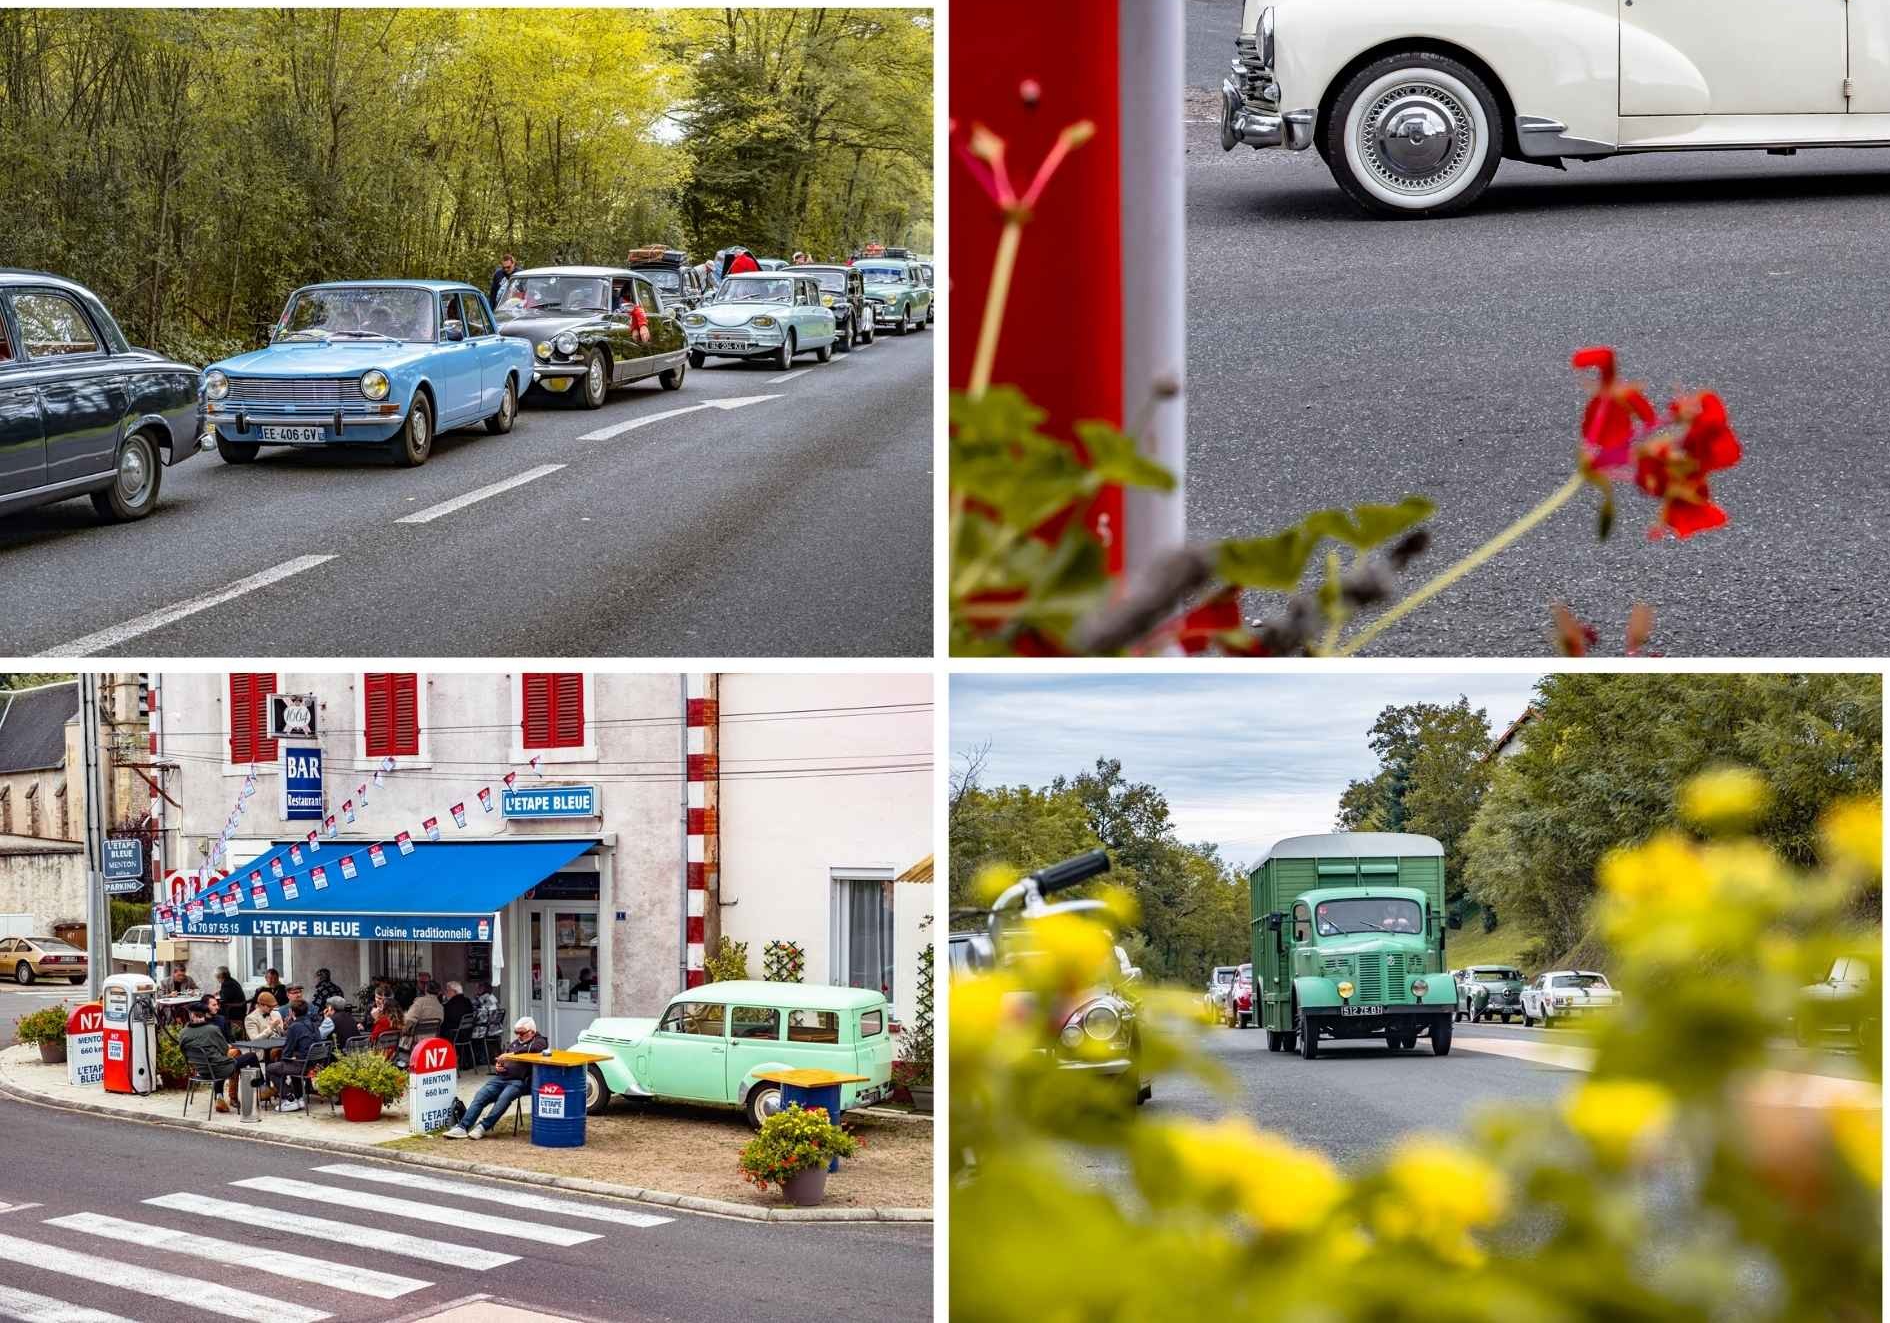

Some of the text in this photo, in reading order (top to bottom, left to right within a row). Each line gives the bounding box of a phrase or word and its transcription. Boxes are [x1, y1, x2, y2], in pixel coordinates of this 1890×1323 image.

[264, 429, 316, 440] EE-406-GV
[286, 708, 308, 724] 1664
[288, 756, 320, 778] BAR
[288, 794, 322, 806] Restaurant
[506, 796, 590, 810] L'ETAPE BLEUE
[108, 842, 136, 850] L'ETAPE
[111, 850, 134, 858] BLEUE
[105, 882, 137, 891] PARKING
[188, 924, 240, 934] 04 70 97 55 15
[253, 920, 360, 936] L'ETAPE BLEUE
[374, 926, 472, 939] Cuisine traditionnelle
[80, 1013, 102, 1030] N7
[80, 1046, 92, 1054] 660
[425, 1048, 448, 1069] N7
[422, 1074, 451, 1086] MENTON
[425, 1087, 448, 1097] 660 km
[544, 1085, 558, 1094] N7
[422, 1107, 452, 1122] L'ETAPE
[424, 1118, 450, 1132] BLEUE
